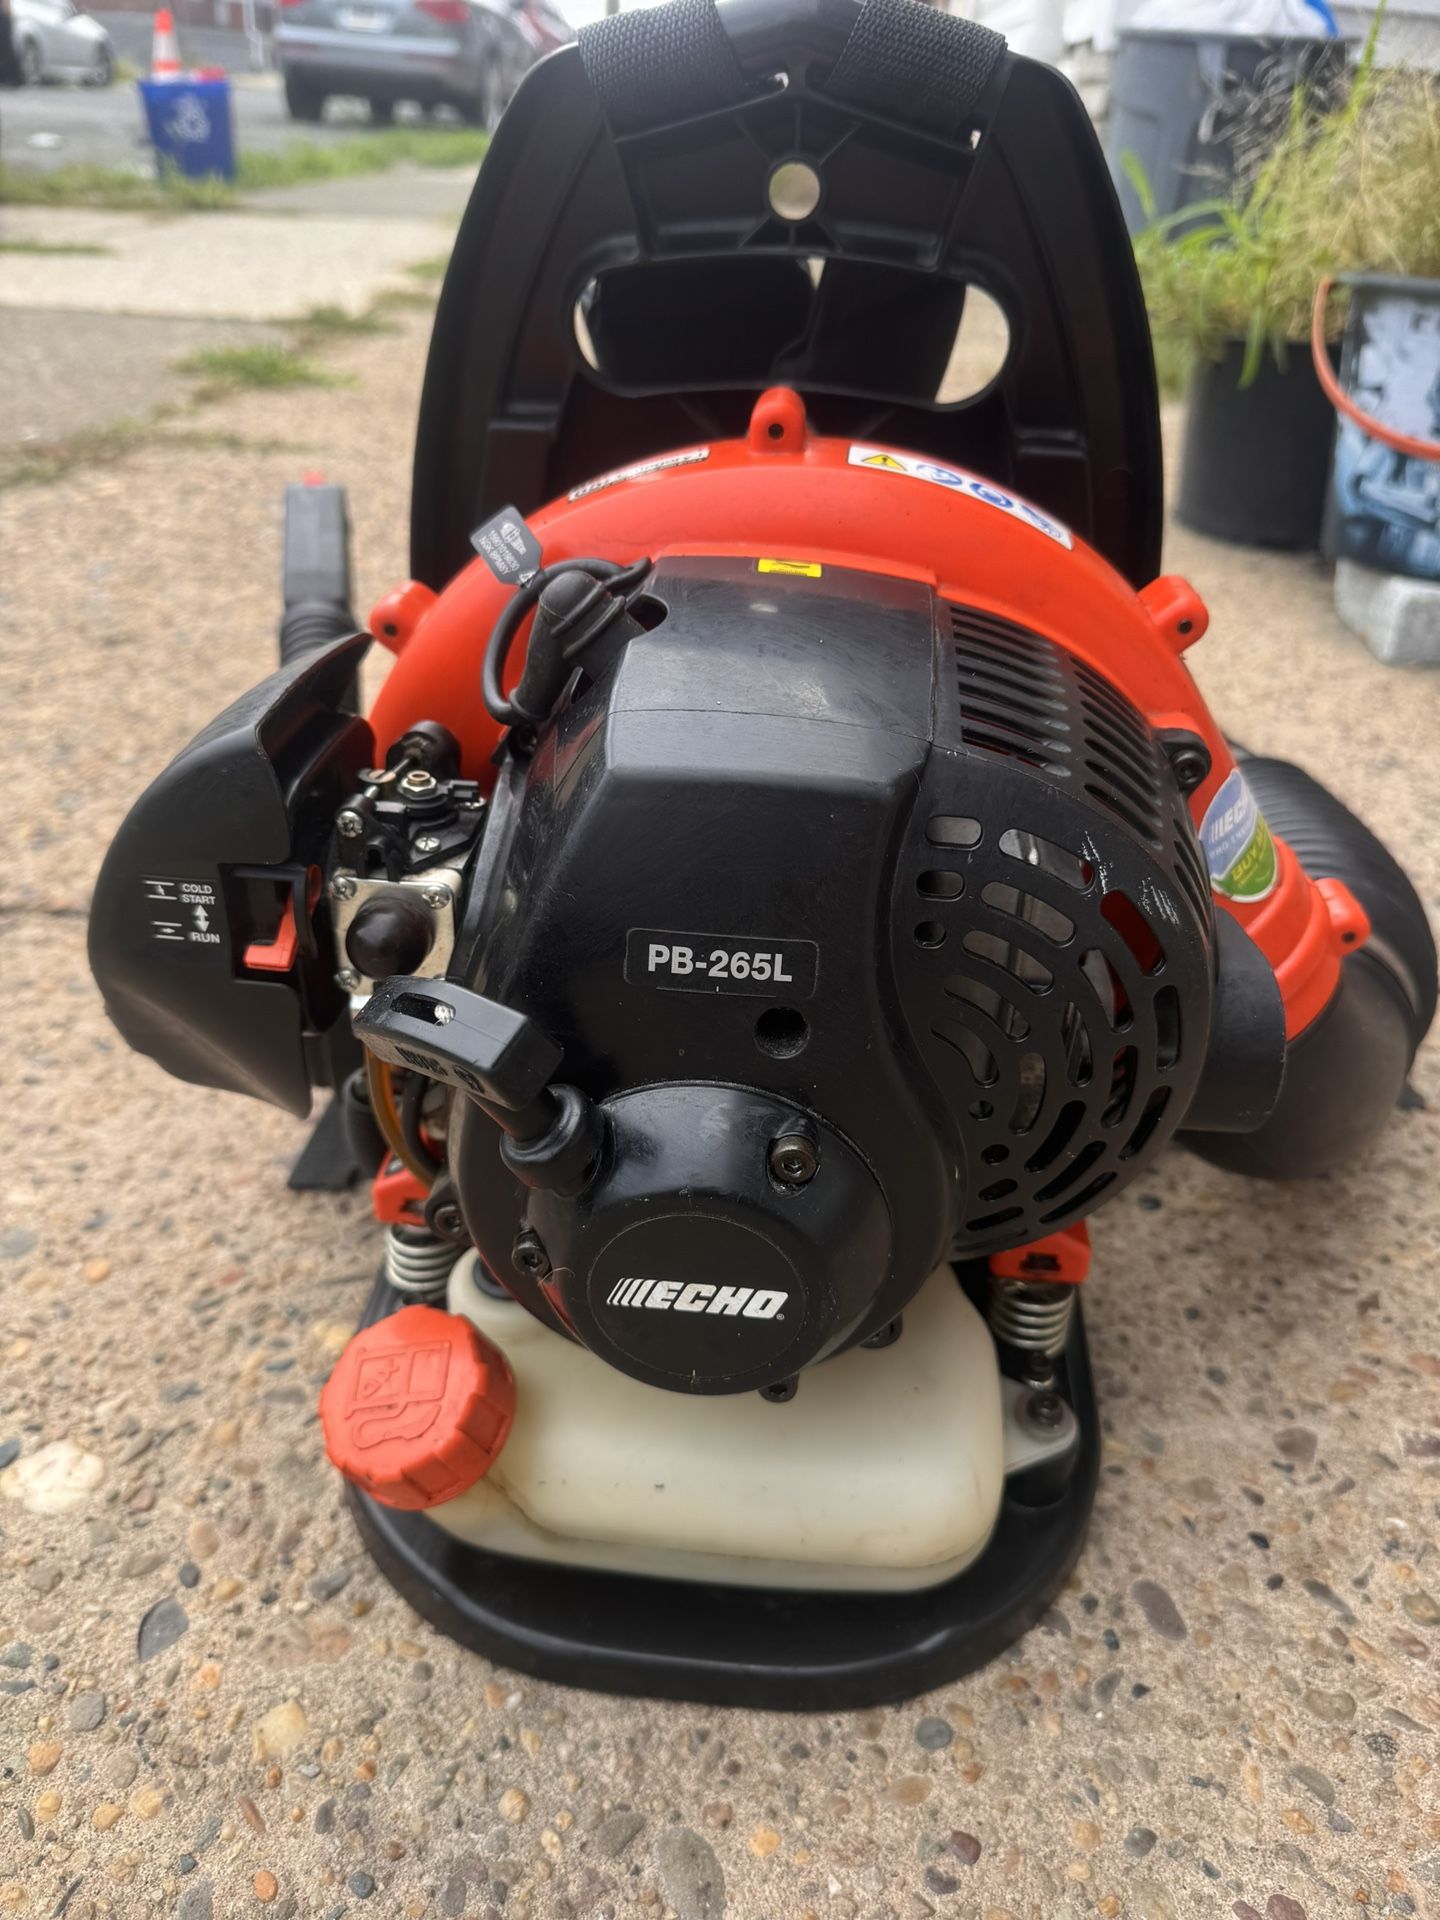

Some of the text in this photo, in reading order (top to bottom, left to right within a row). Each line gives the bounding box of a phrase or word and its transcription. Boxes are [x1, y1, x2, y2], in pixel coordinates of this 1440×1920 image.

[181, 883, 212, 894] COLD
[181, 894, 216, 905] START
[190, 931, 220, 943] RUN
[648, 943, 793, 983] PB-265L
[607, 1277, 789, 1320] ECHO
